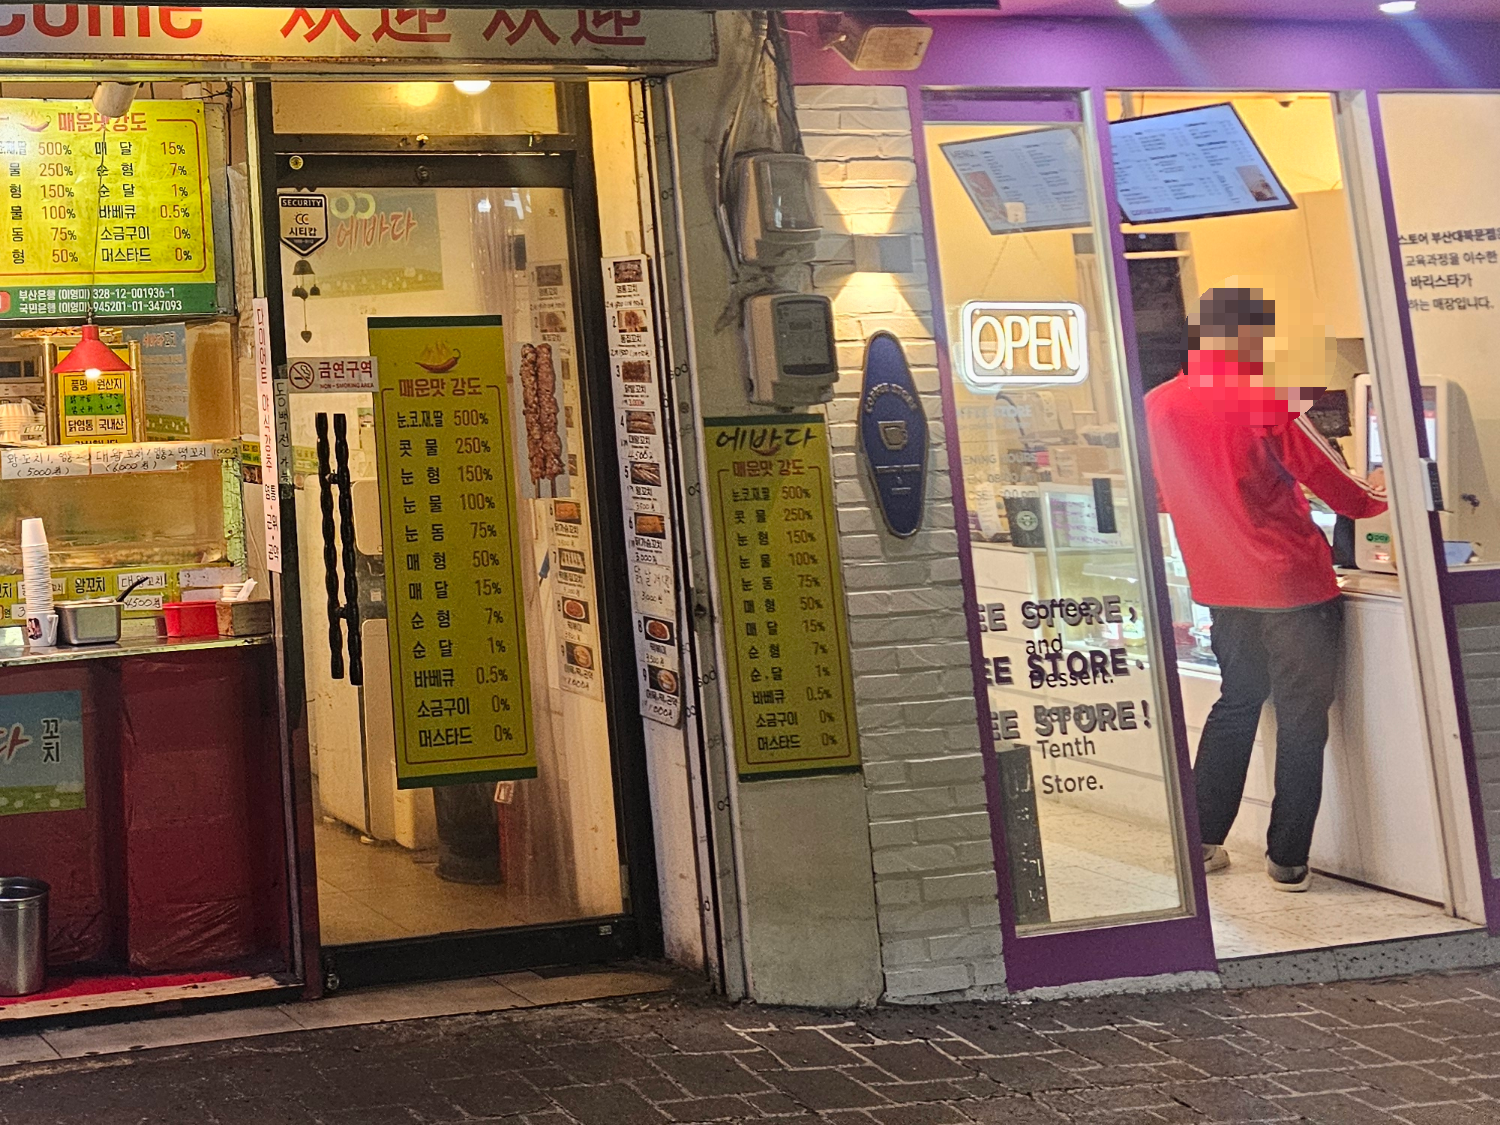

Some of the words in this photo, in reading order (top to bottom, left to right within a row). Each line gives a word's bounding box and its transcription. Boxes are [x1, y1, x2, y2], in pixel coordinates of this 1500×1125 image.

[38, 141, 72, 156] 500%
[160, 141, 186, 155] 15%
[39, 162, 73, 177] 250%
[170, 163, 187, 176] 7%
[40, 184, 74, 199] 150%
[172, 184, 188, 197] 1%
[41, 205, 76, 220] 100%
[99, 205, 136, 219] 바베큐
[160, 204, 190, 219] 0.5%
[52, 227, 77, 241] 75%
[100, 225, 151, 241] 소금구이
[174, 226, 191, 239] 0%
[52, 249, 79, 263] 50%
[101, 248, 151, 263] 머스타드
[175, 247, 192, 261] 0%
[1410, 273, 1473, 289] 바리스타가
[18, 289, 56, 301] 부산은행
[93, 287, 175, 300] 328-12-001936-1
[19, 303, 56, 315] 국민은행
[93, 300, 182, 312] 945201-01-347093
[972, 315, 1080, 370] OPEN
[318, 361, 372, 378] 금연구역
[97, 378, 122, 390] 원산지
[398, 378, 446, 398] 매운맛
[450, 377, 482, 397] 강도
[68, 420, 93, 432] 닭염통
[99, 418, 124, 431] 국내산
[454, 409, 489, 426] 500%
[455, 437, 491, 454] 250%
[716, 427, 817, 452] 에바다
[458, 465, 493, 482] 150%
[732, 460, 773, 478] 매운맛
[777, 459, 806, 476] 강도
[781, 486, 811, 500] 500%
[459, 493, 496, 510] 100%
[784, 508, 813, 522] 250%
[470, 521, 497, 539] 75%
[786, 530, 817, 544] 150%
[473, 550, 499, 567] 50%
[788, 553, 818, 567] 100%
[75, 576, 106, 594] 왕꼬치
[475, 579, 501, 596] 15%
[798, 575, 821, 588] 75%
[800, 597, 823, 611] 50%
[485, 608, 504, 625] 7%
[802, 619, 826, 633] 15%
[487, 637, 506, 654] 1%
[812, 642, 828, 655] 7%
[1026, 633, 1063, 655] and
[414, 668, 455, 688] 바베큐
[476, 666, 508, 684] 0.5%
[815, 664, 830, 677] 1%
[752, 689, 785, 705] 바베큐
[806, 687, 833, 701] 0.5%
[417, 697, 470, 718] 소금구이
[492, 695, 510, 713] 0%
[755, 712, 798, 728] 소금구이
[819, 710, 835, 724] 0%
[42, 719, 60, 763] 꼬치
[419, 727, 473, 748] 머스타드
[494, 724, 513, 742] 0%
[758, 734, 802, 751] 머스타드
[822, 733, 838, 746] 0%
[1037, 736, 1096, 759] Tenth
[1042, 775, 1104, 794] Store.
